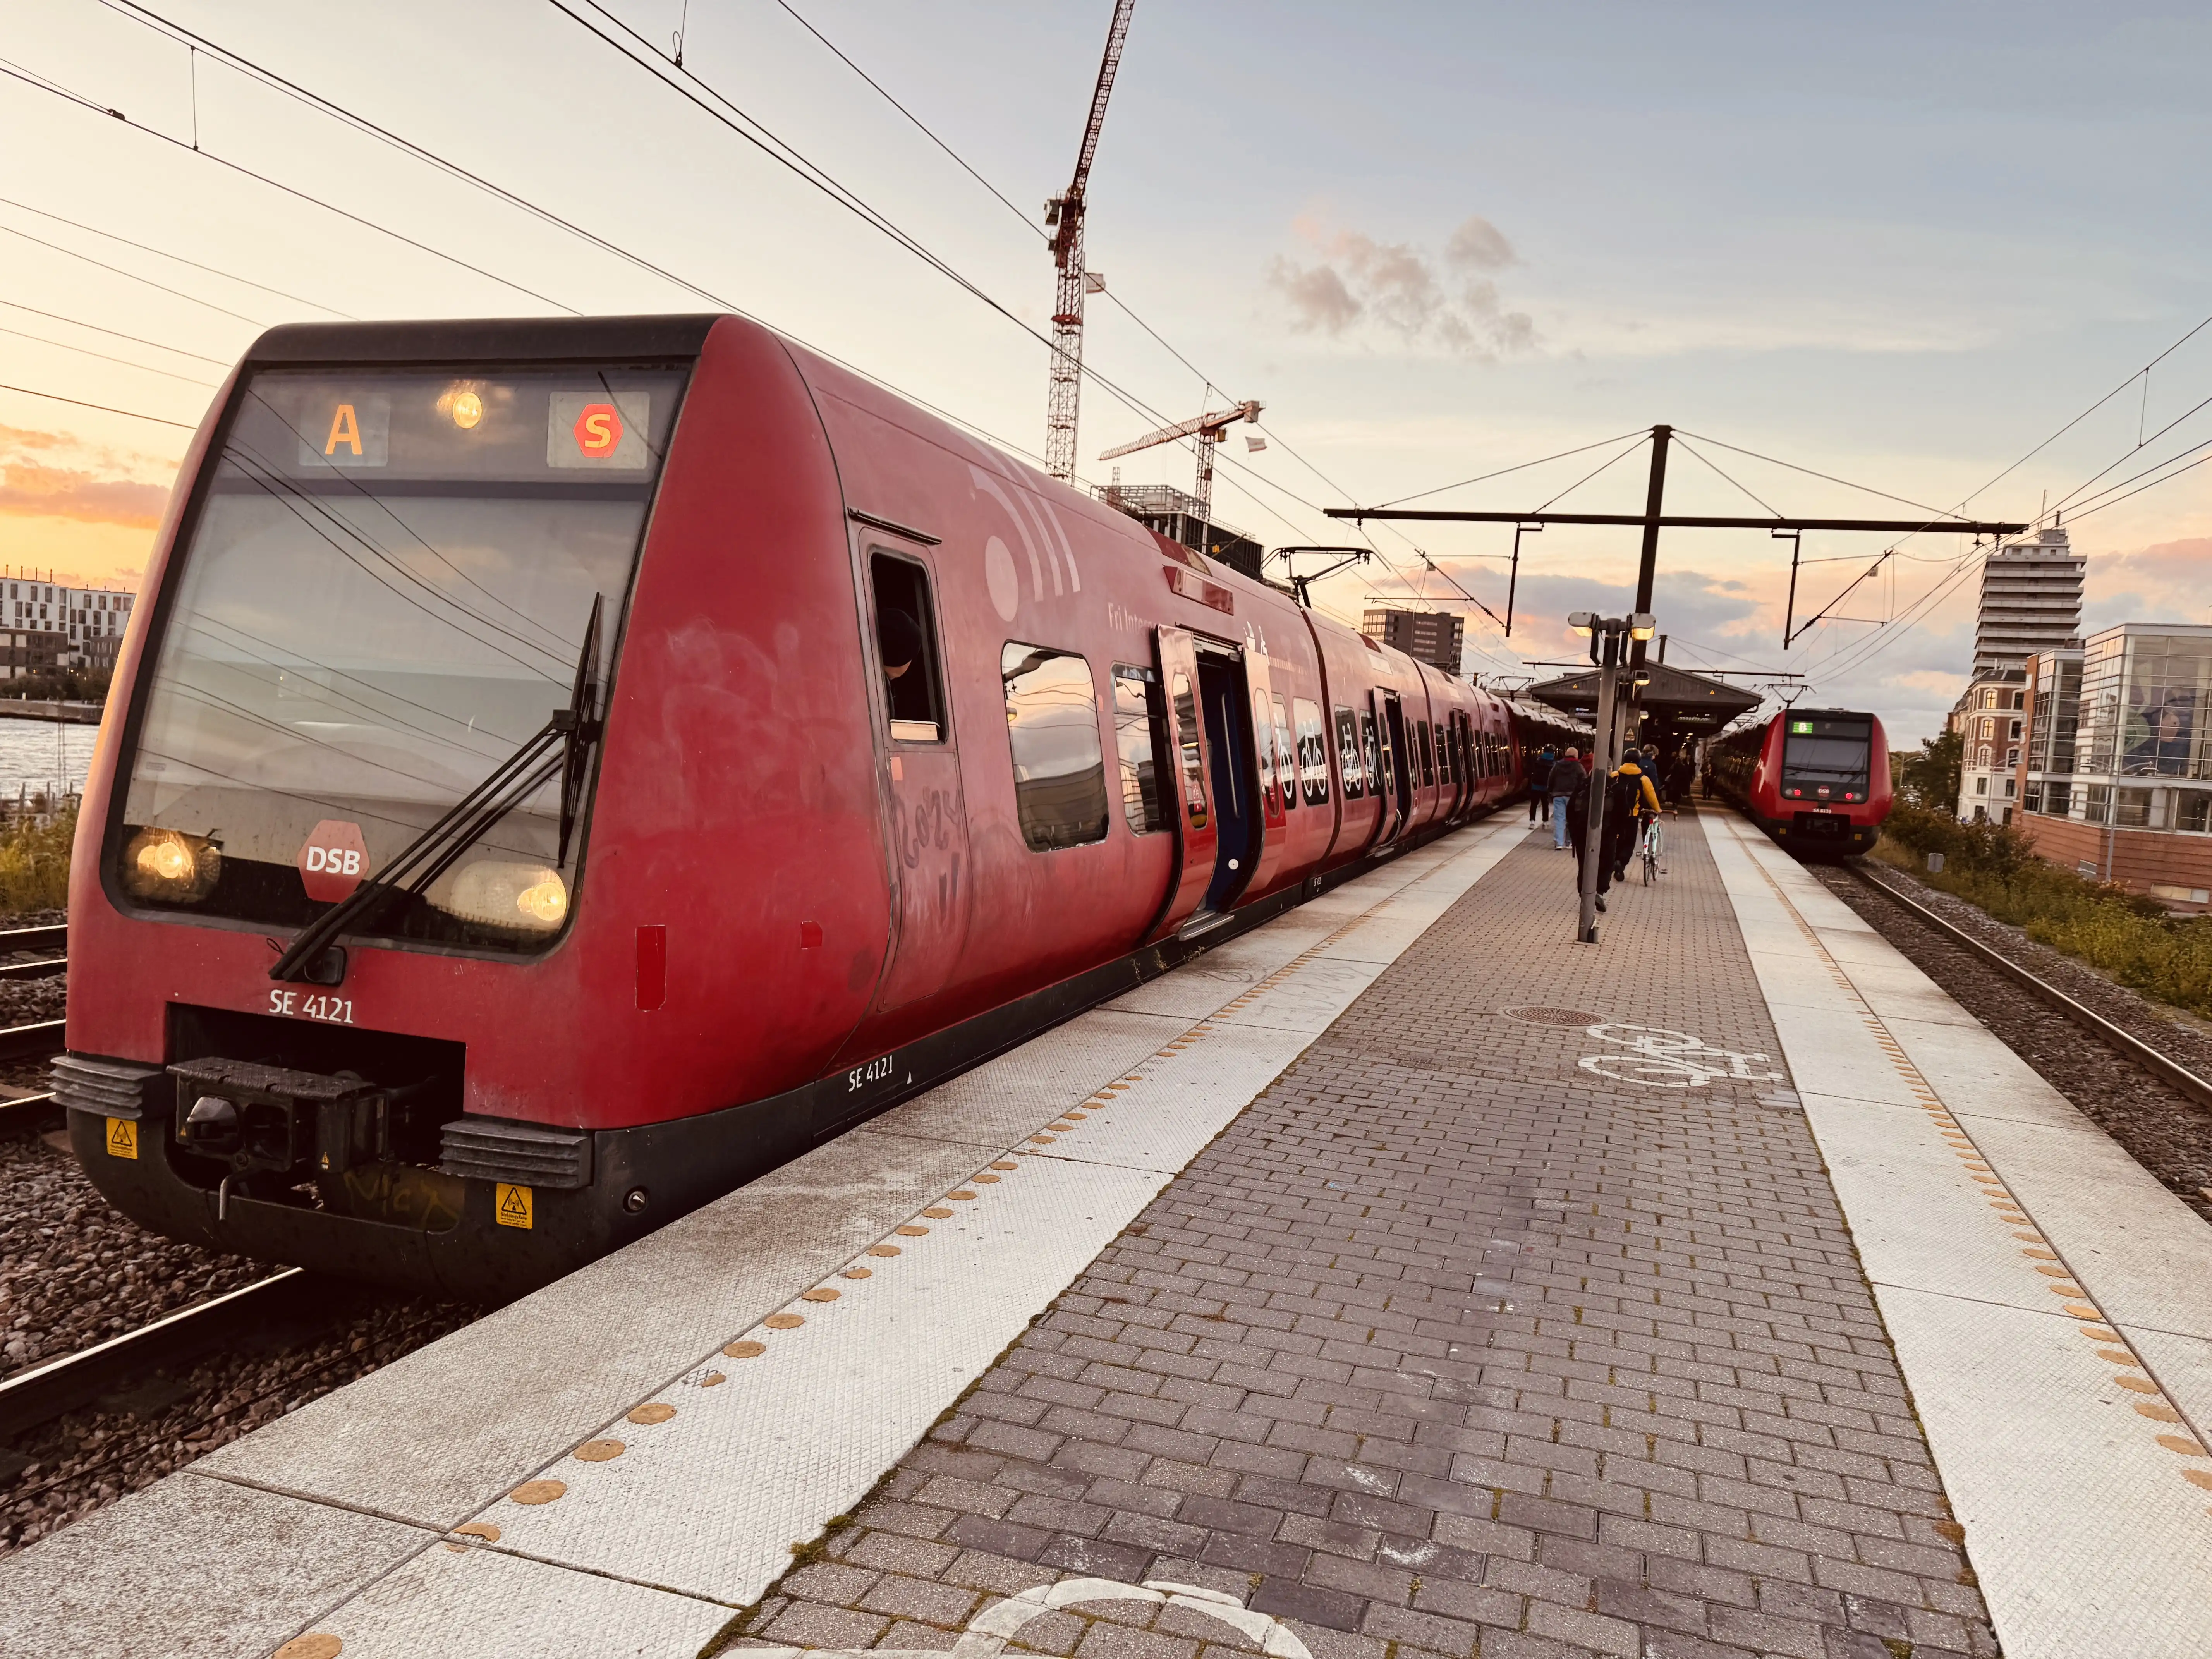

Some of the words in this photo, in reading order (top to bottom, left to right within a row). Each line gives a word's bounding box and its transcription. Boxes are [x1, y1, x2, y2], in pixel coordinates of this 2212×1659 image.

[325, 405, 362, 455] A
[584, 413, 611, 448] S
[306, 846, 361, 875] DSB
[269, 989, 297, 1015] SE
[302, 994, 354, 1024] 4121
[848, 1067, 863, 1092] SE
[866, 1055, 892, 1082] 4121
